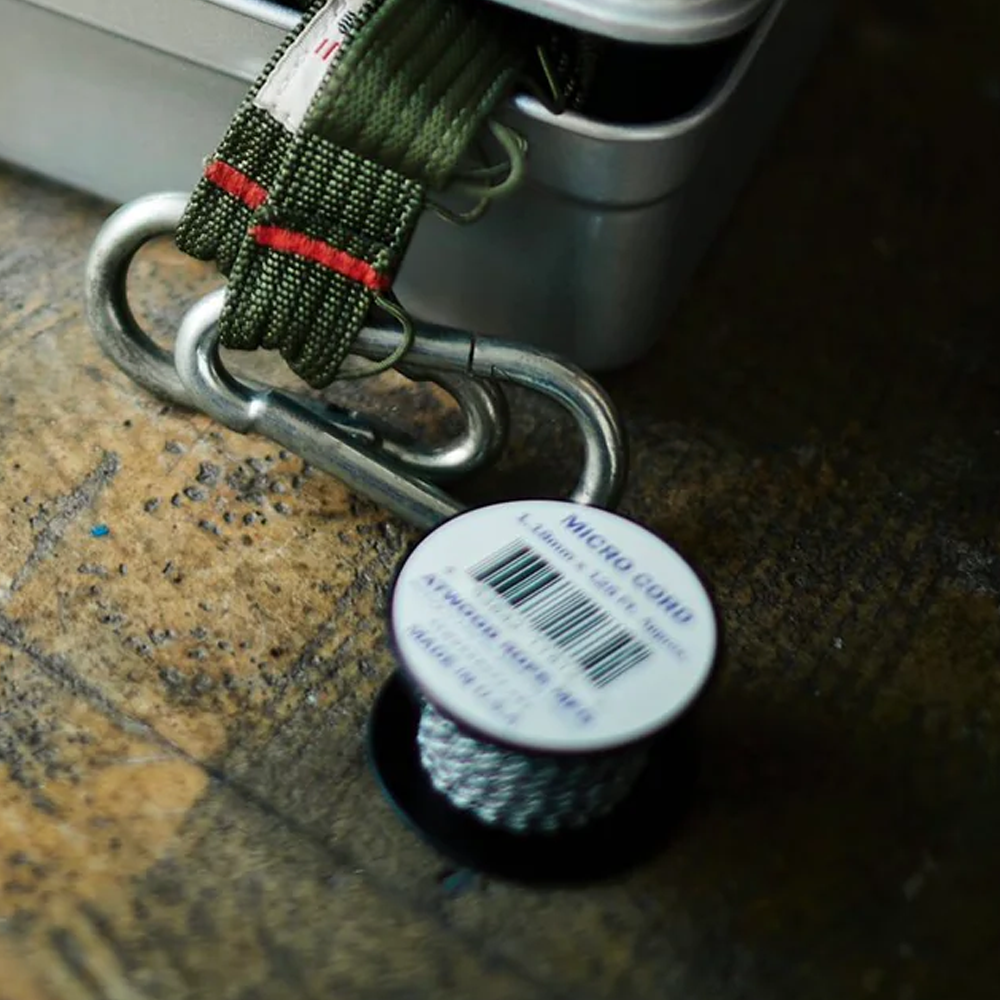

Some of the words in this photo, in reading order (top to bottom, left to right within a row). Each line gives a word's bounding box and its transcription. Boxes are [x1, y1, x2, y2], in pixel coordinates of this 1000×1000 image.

[422, 573, 499, 640] ATWOOD
[561, 513, 634, 573] MICRO
[631, 573, 694, 625] CORD
